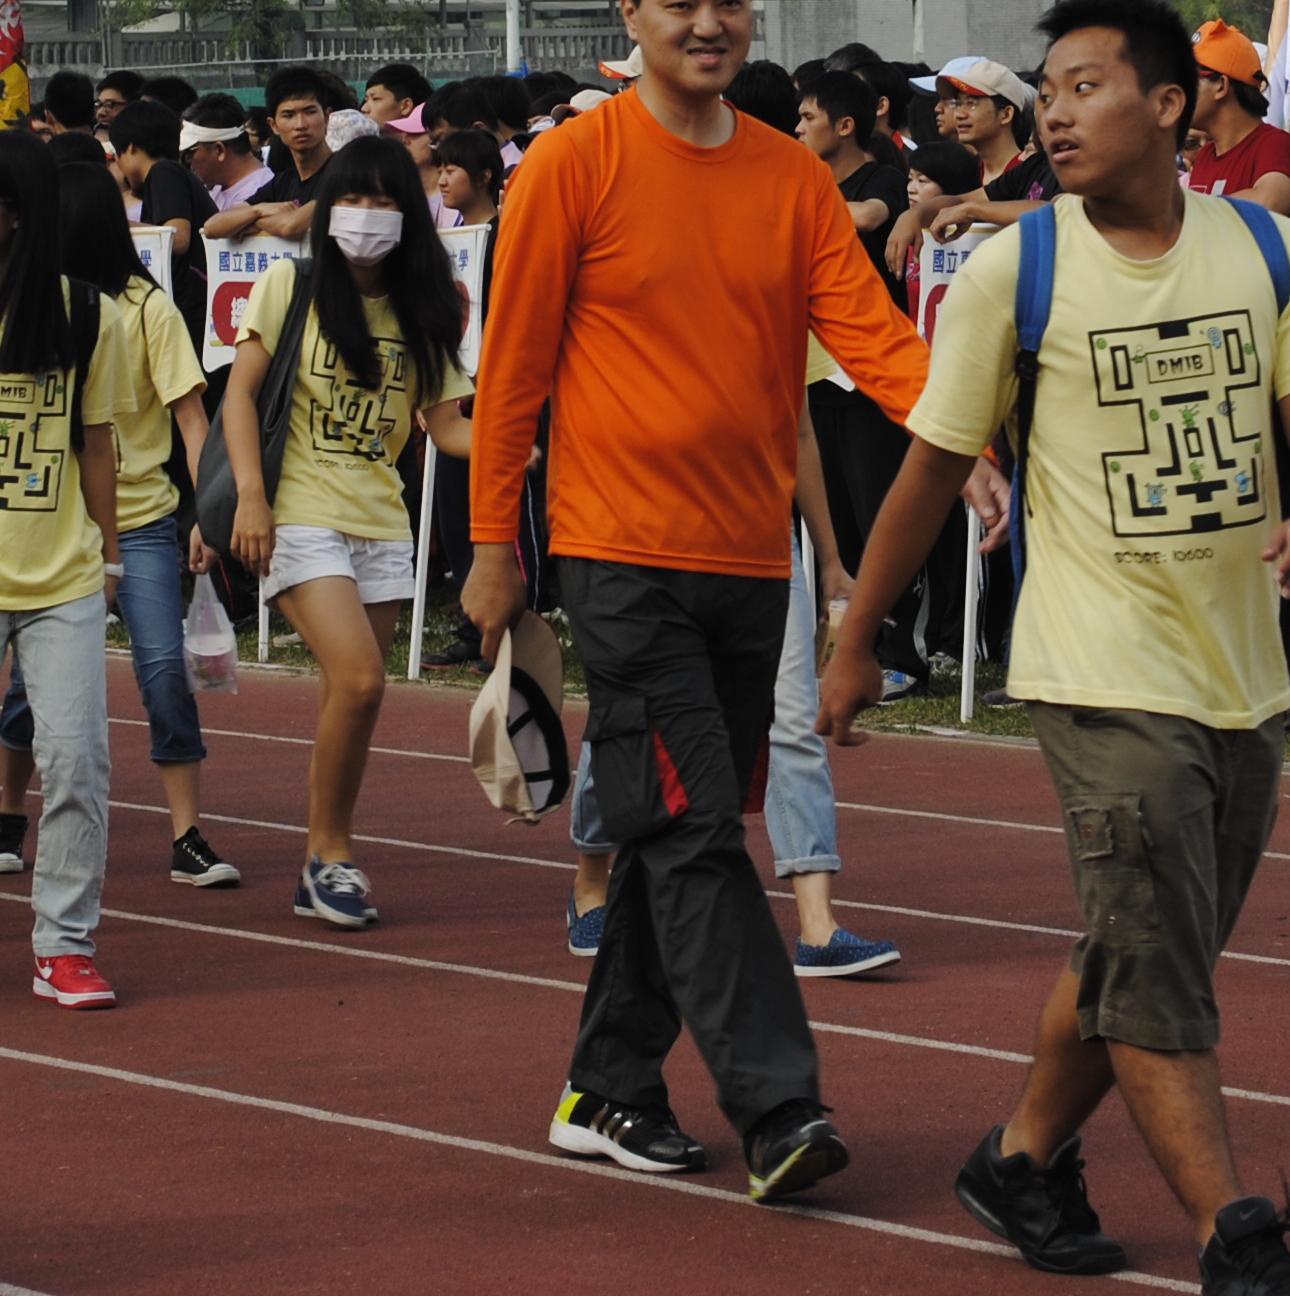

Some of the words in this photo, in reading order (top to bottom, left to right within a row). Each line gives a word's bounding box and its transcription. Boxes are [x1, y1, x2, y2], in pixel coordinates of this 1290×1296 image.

[1157, 354, 1205, 377] DMIB
[1114, 550, 1167, 564] SCORE:
[1173, 548, 1214, 562] 10600
